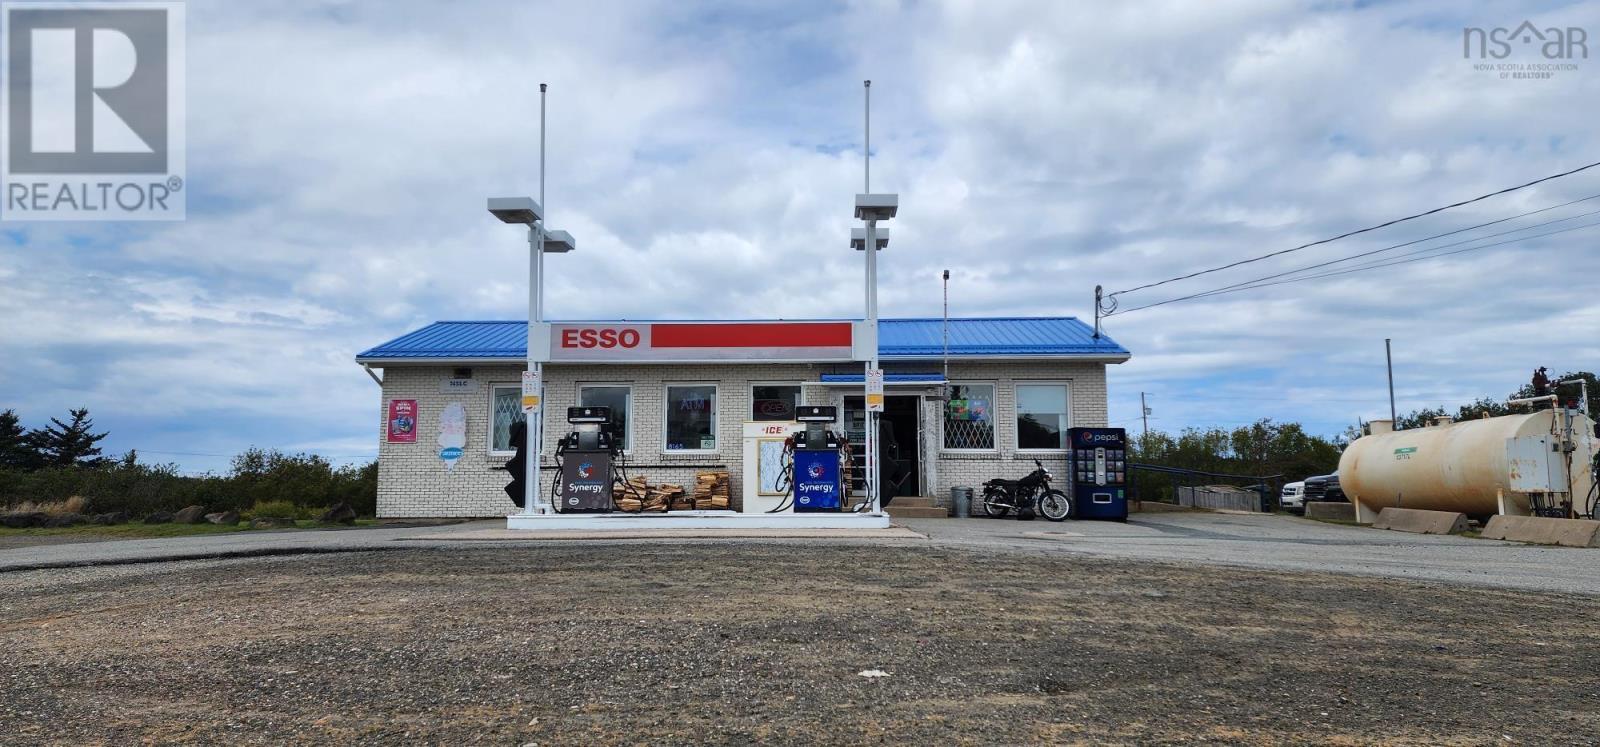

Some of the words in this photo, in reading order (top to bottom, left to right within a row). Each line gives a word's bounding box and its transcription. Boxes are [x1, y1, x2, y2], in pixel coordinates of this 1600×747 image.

[561, 328, 641, 349] ESSO
[765, 426, 783, 434] ICE
[1094, 433, 1119, 443] pepsi
[569, 483, 604, 494] Synergy
[799, 482, 834, 493] Synergy
